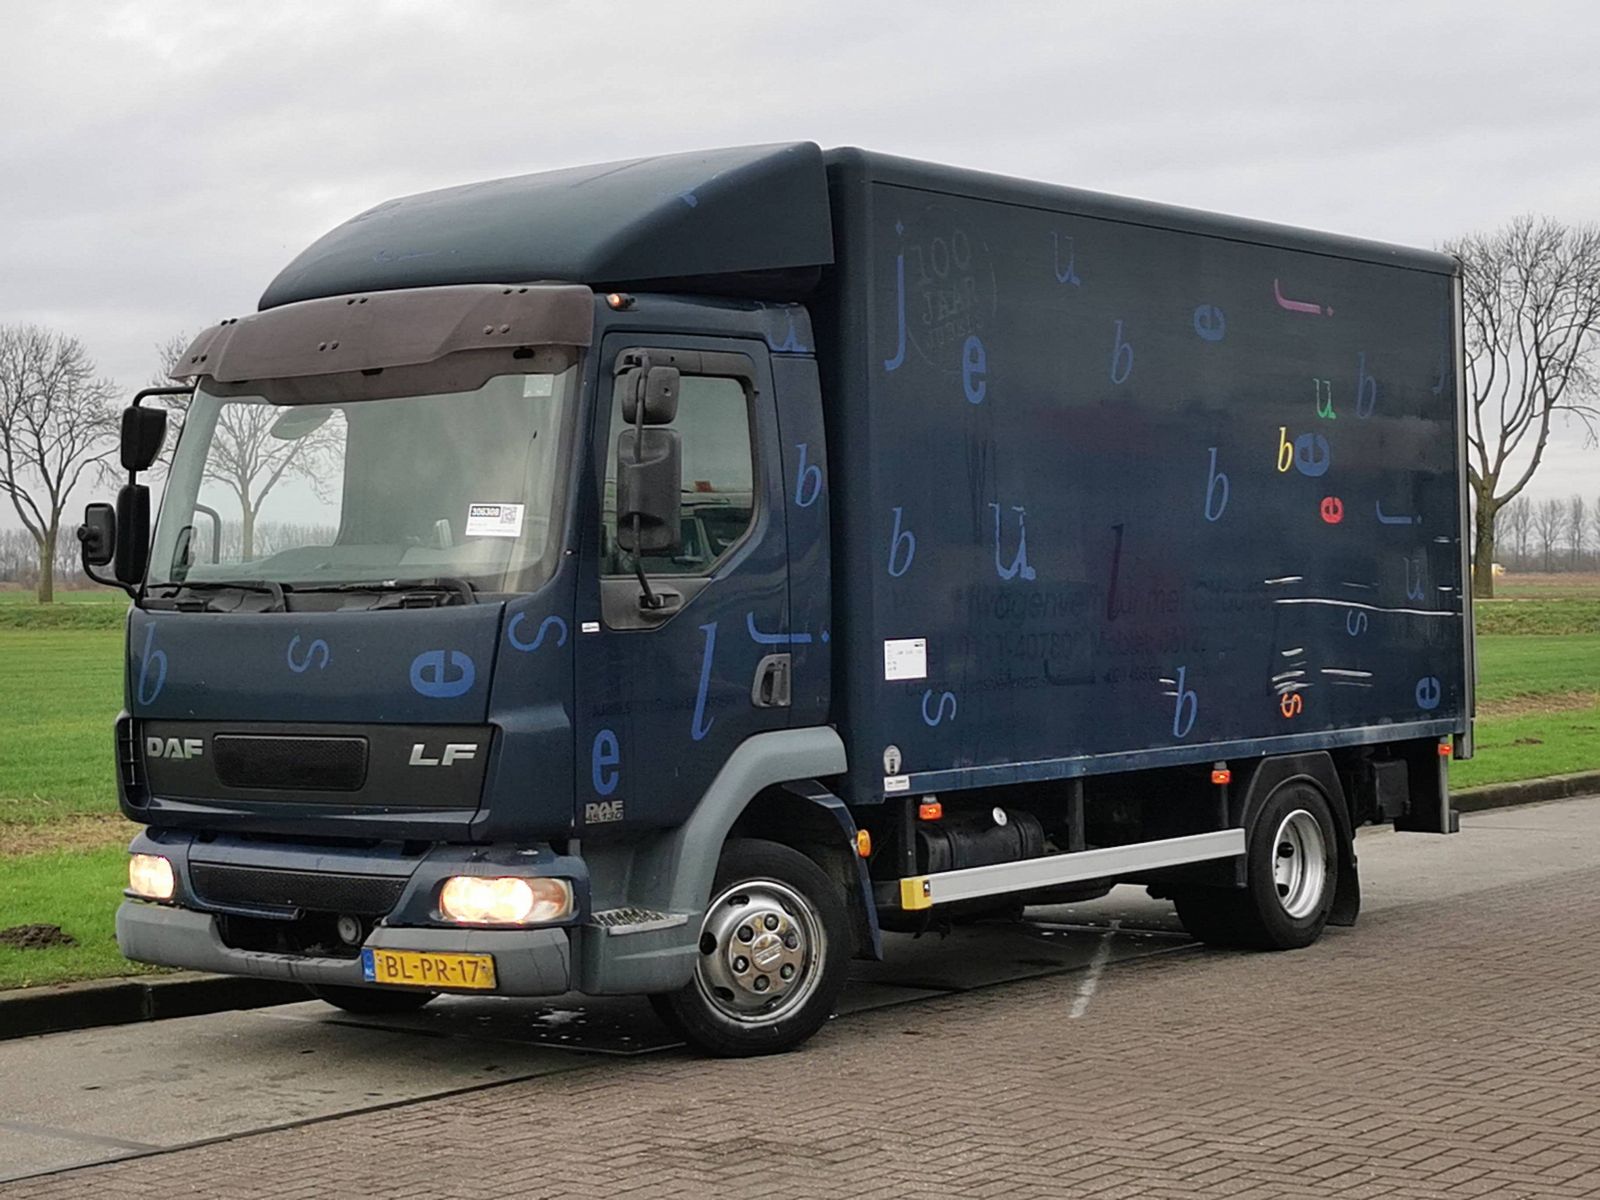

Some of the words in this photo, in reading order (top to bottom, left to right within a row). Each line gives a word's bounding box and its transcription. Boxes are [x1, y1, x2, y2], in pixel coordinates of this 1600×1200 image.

[963, 335, 986, 404] e
[795, 444, 822, 507] b
[1278, 427, 1293, 471] b
[1205, 448, 1229, 521] b
[1321, 496, 1344, 524] e
[887, 506, 916, 577] b
[988, 502, 1036, 582] u
[137, 622, 168, 707] b
[410, 650, 475, 698] e
[1172, 666, 1198, 738] b
[146, 736, 203, 760] DAF
[408, 743, 478, 767] LF
[591, 729, 621, 796] e
[585, 800, 624, 820] DAF
[385, 954, 479, 982] BL-PR-17
